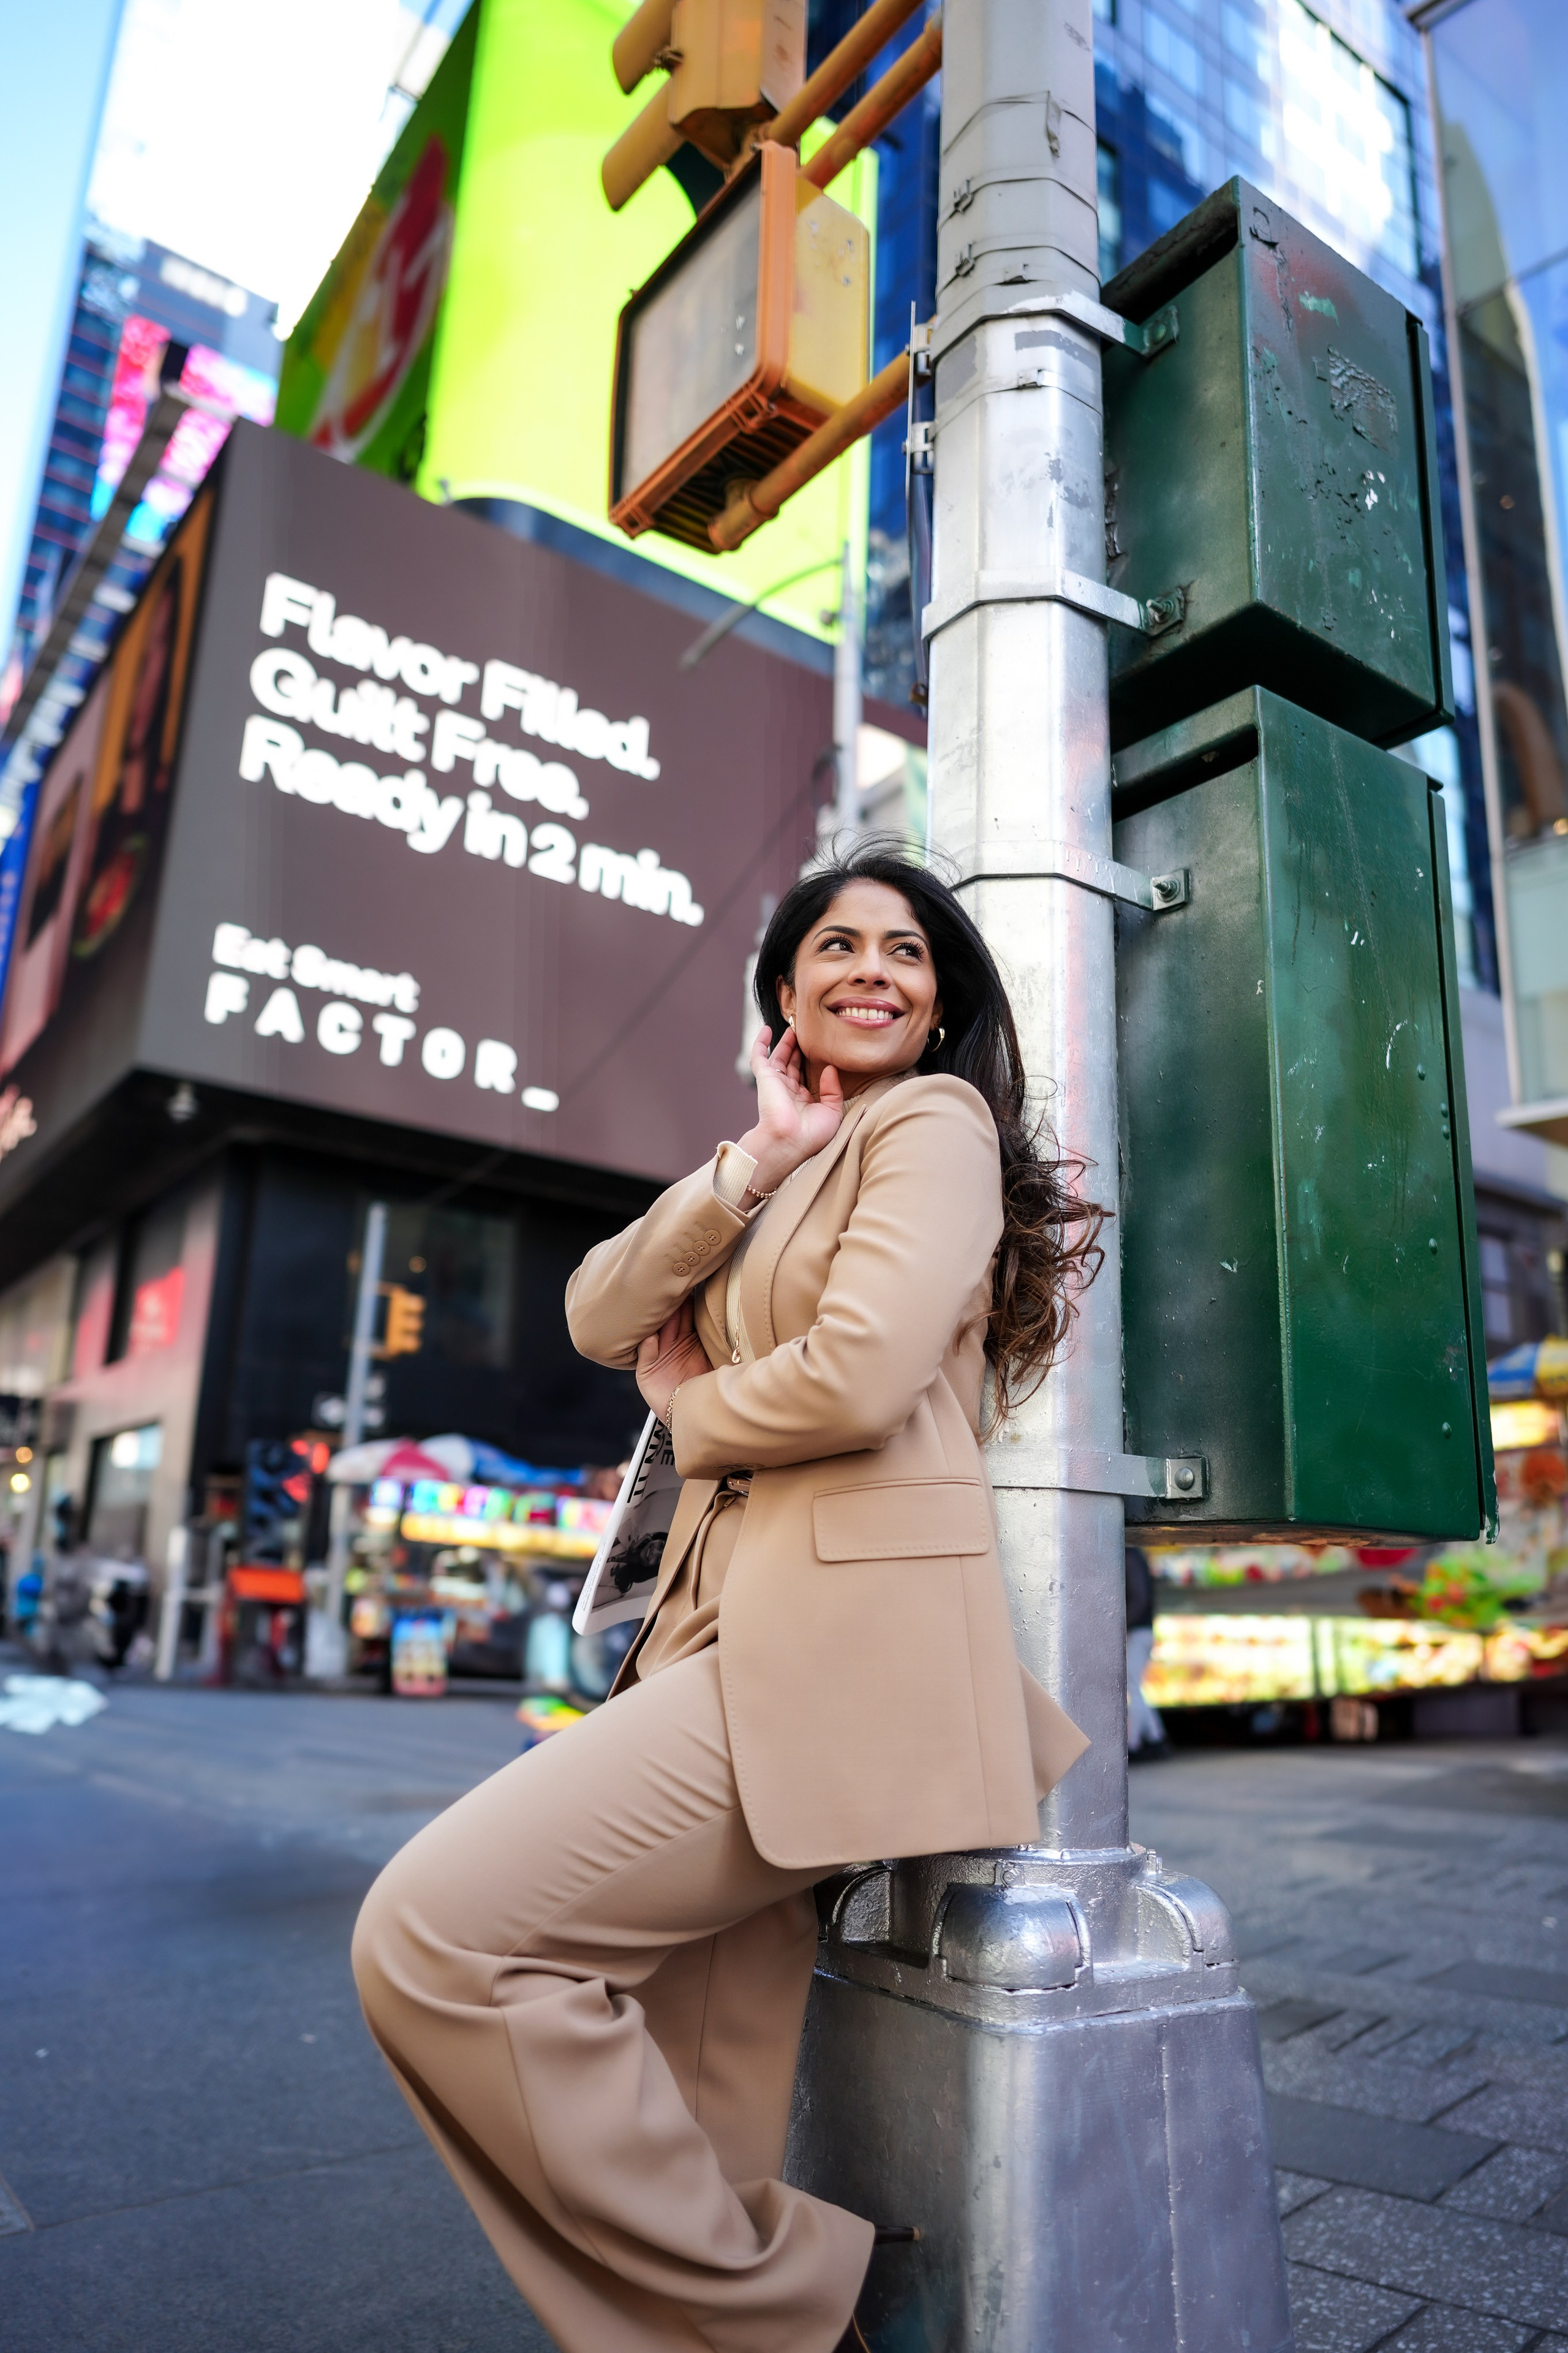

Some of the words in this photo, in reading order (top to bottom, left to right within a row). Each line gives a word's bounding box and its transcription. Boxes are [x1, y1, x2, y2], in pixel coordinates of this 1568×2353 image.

[260, 572, 480, 705] Flavor
[480, 659, 660, 780] Filled.
[239, 714, 464, 854] Ready
[464, 790, 528, 868] in
[527, 823, 576, 885] 2
[578, 843, 704, 927] min.
[431, 709, 590, 820] Free.
[212, 922, 292, 980] Eat
[291, 944, 420, 1013] Smart
